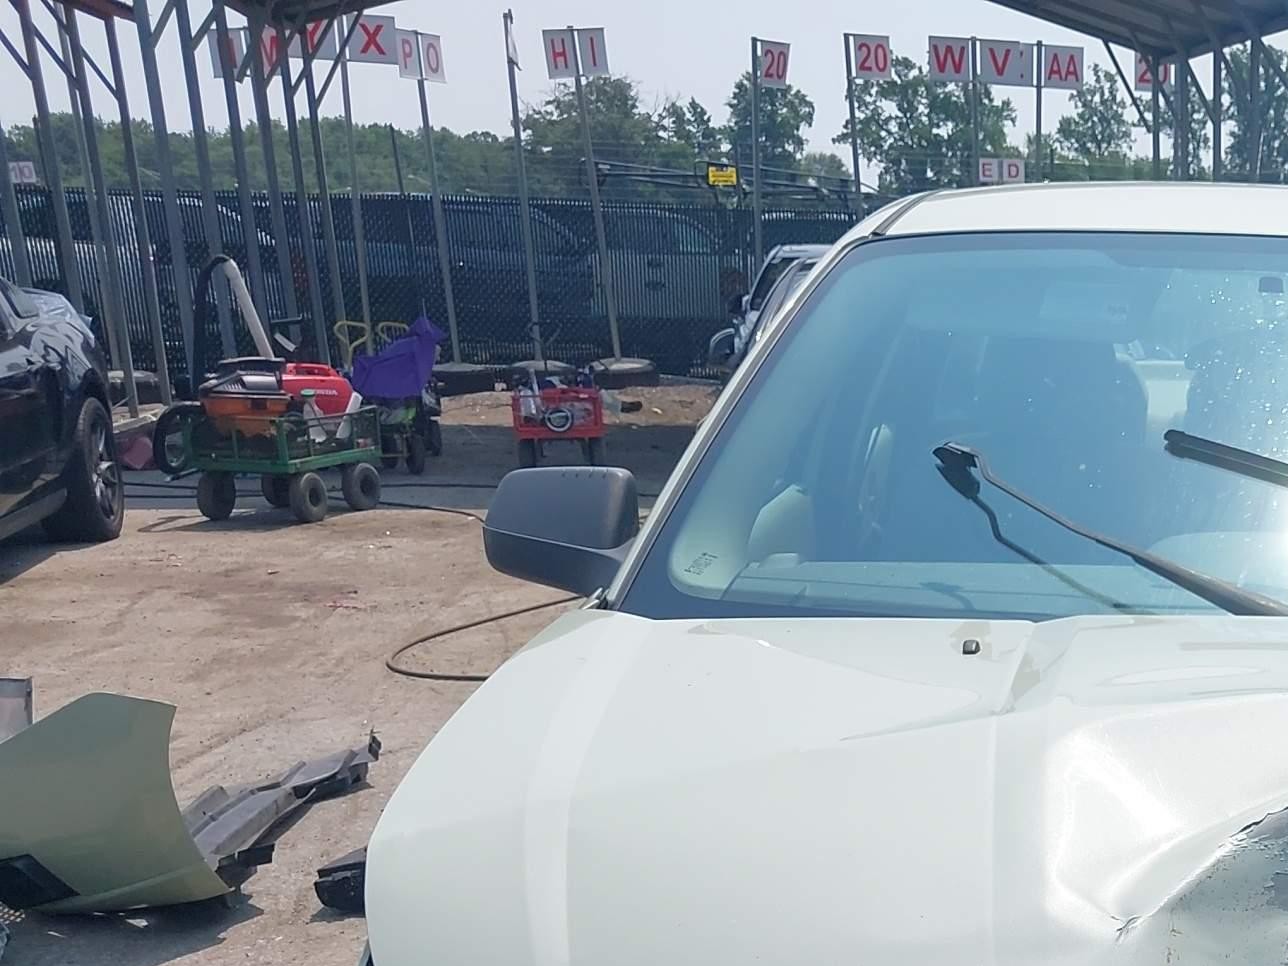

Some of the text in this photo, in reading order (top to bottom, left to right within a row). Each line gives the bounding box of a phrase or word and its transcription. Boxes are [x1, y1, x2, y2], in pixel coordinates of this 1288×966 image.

[359, 23, 386, 55] X
[402, 39, 412, 69] P
[551, 38, 568, 69] H
[764, 49, 787, 80] 20
[857, 42, 888, 73] 20
[933, 44, 966, 74] W
[1047, 52, 1079, 82] AA
[982, 163, 1019, 178] E D
